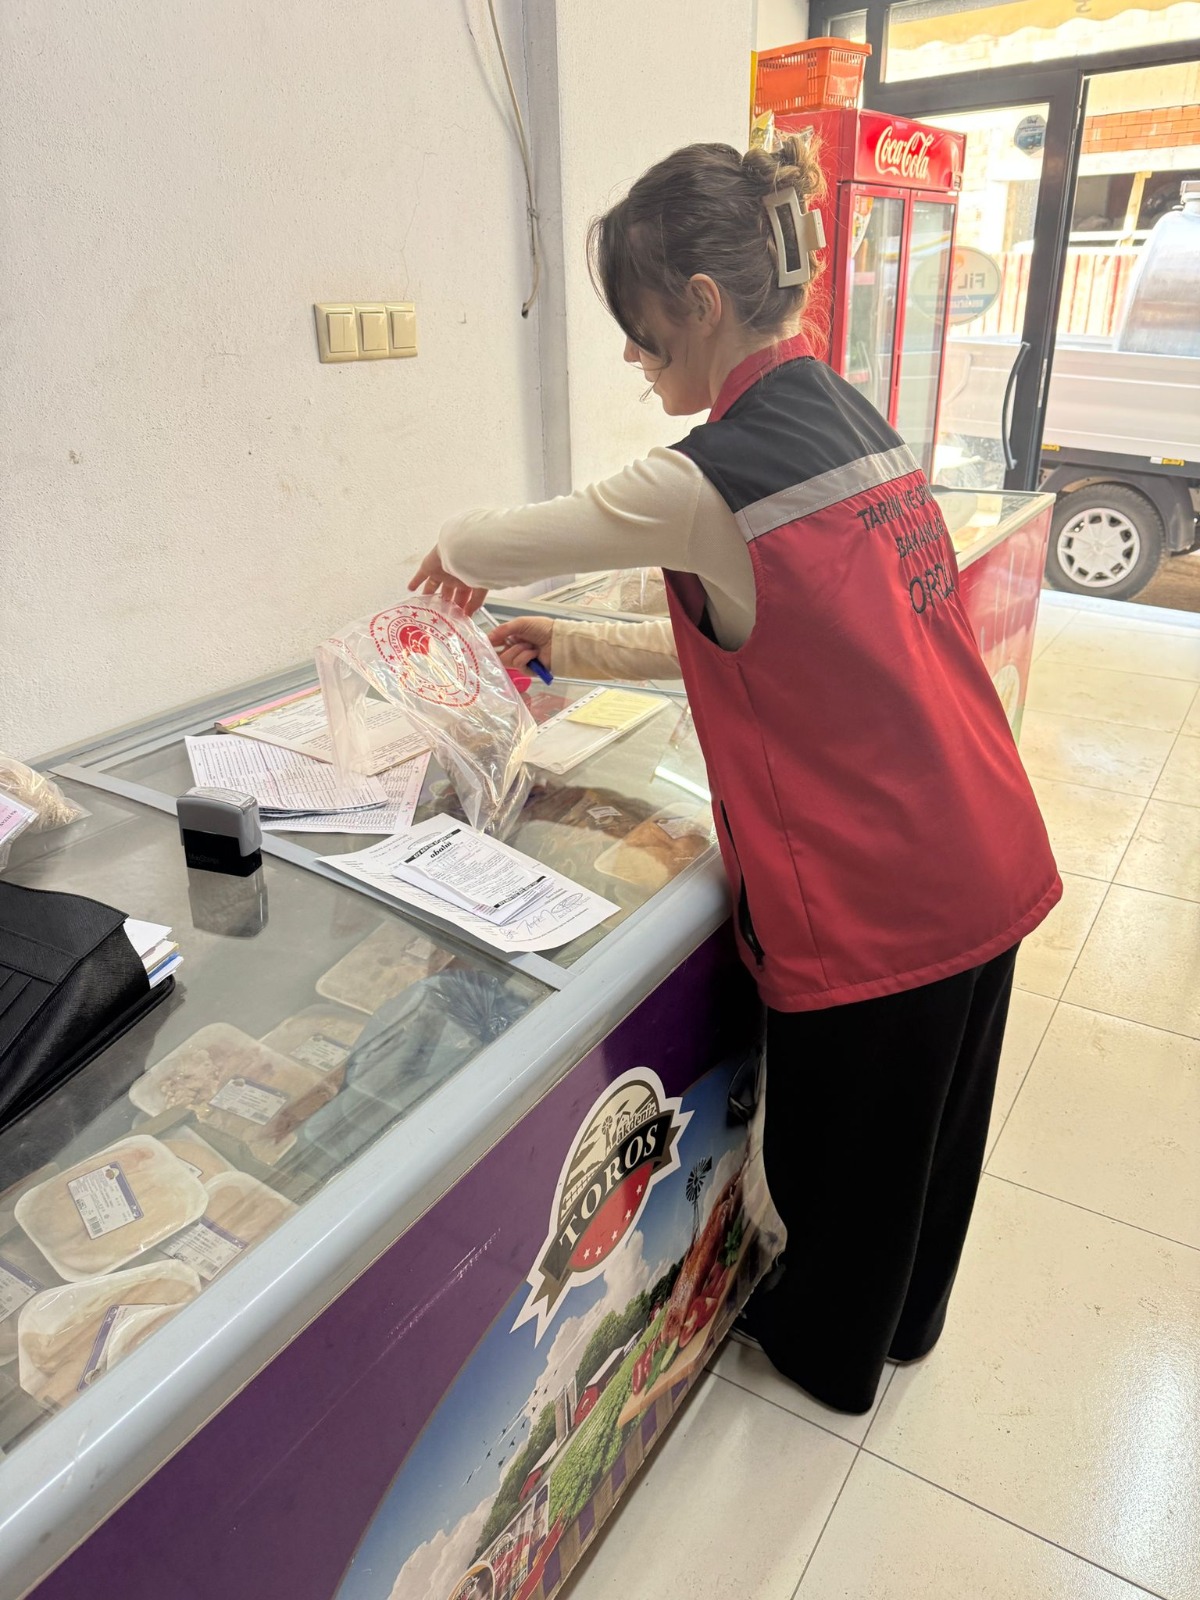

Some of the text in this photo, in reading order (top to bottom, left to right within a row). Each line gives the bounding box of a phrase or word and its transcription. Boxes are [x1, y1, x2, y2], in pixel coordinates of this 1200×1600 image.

[875, 126, 934, 179] Coca-Cola
[857, 496, 904, 531] TARIM
[903, 491, 917, 513] VE
[909, 562, 954, 613] ORDU
[616, 1101, 658, 1141] akdeniz
[559, 1124, 659, 1250] TOROS
